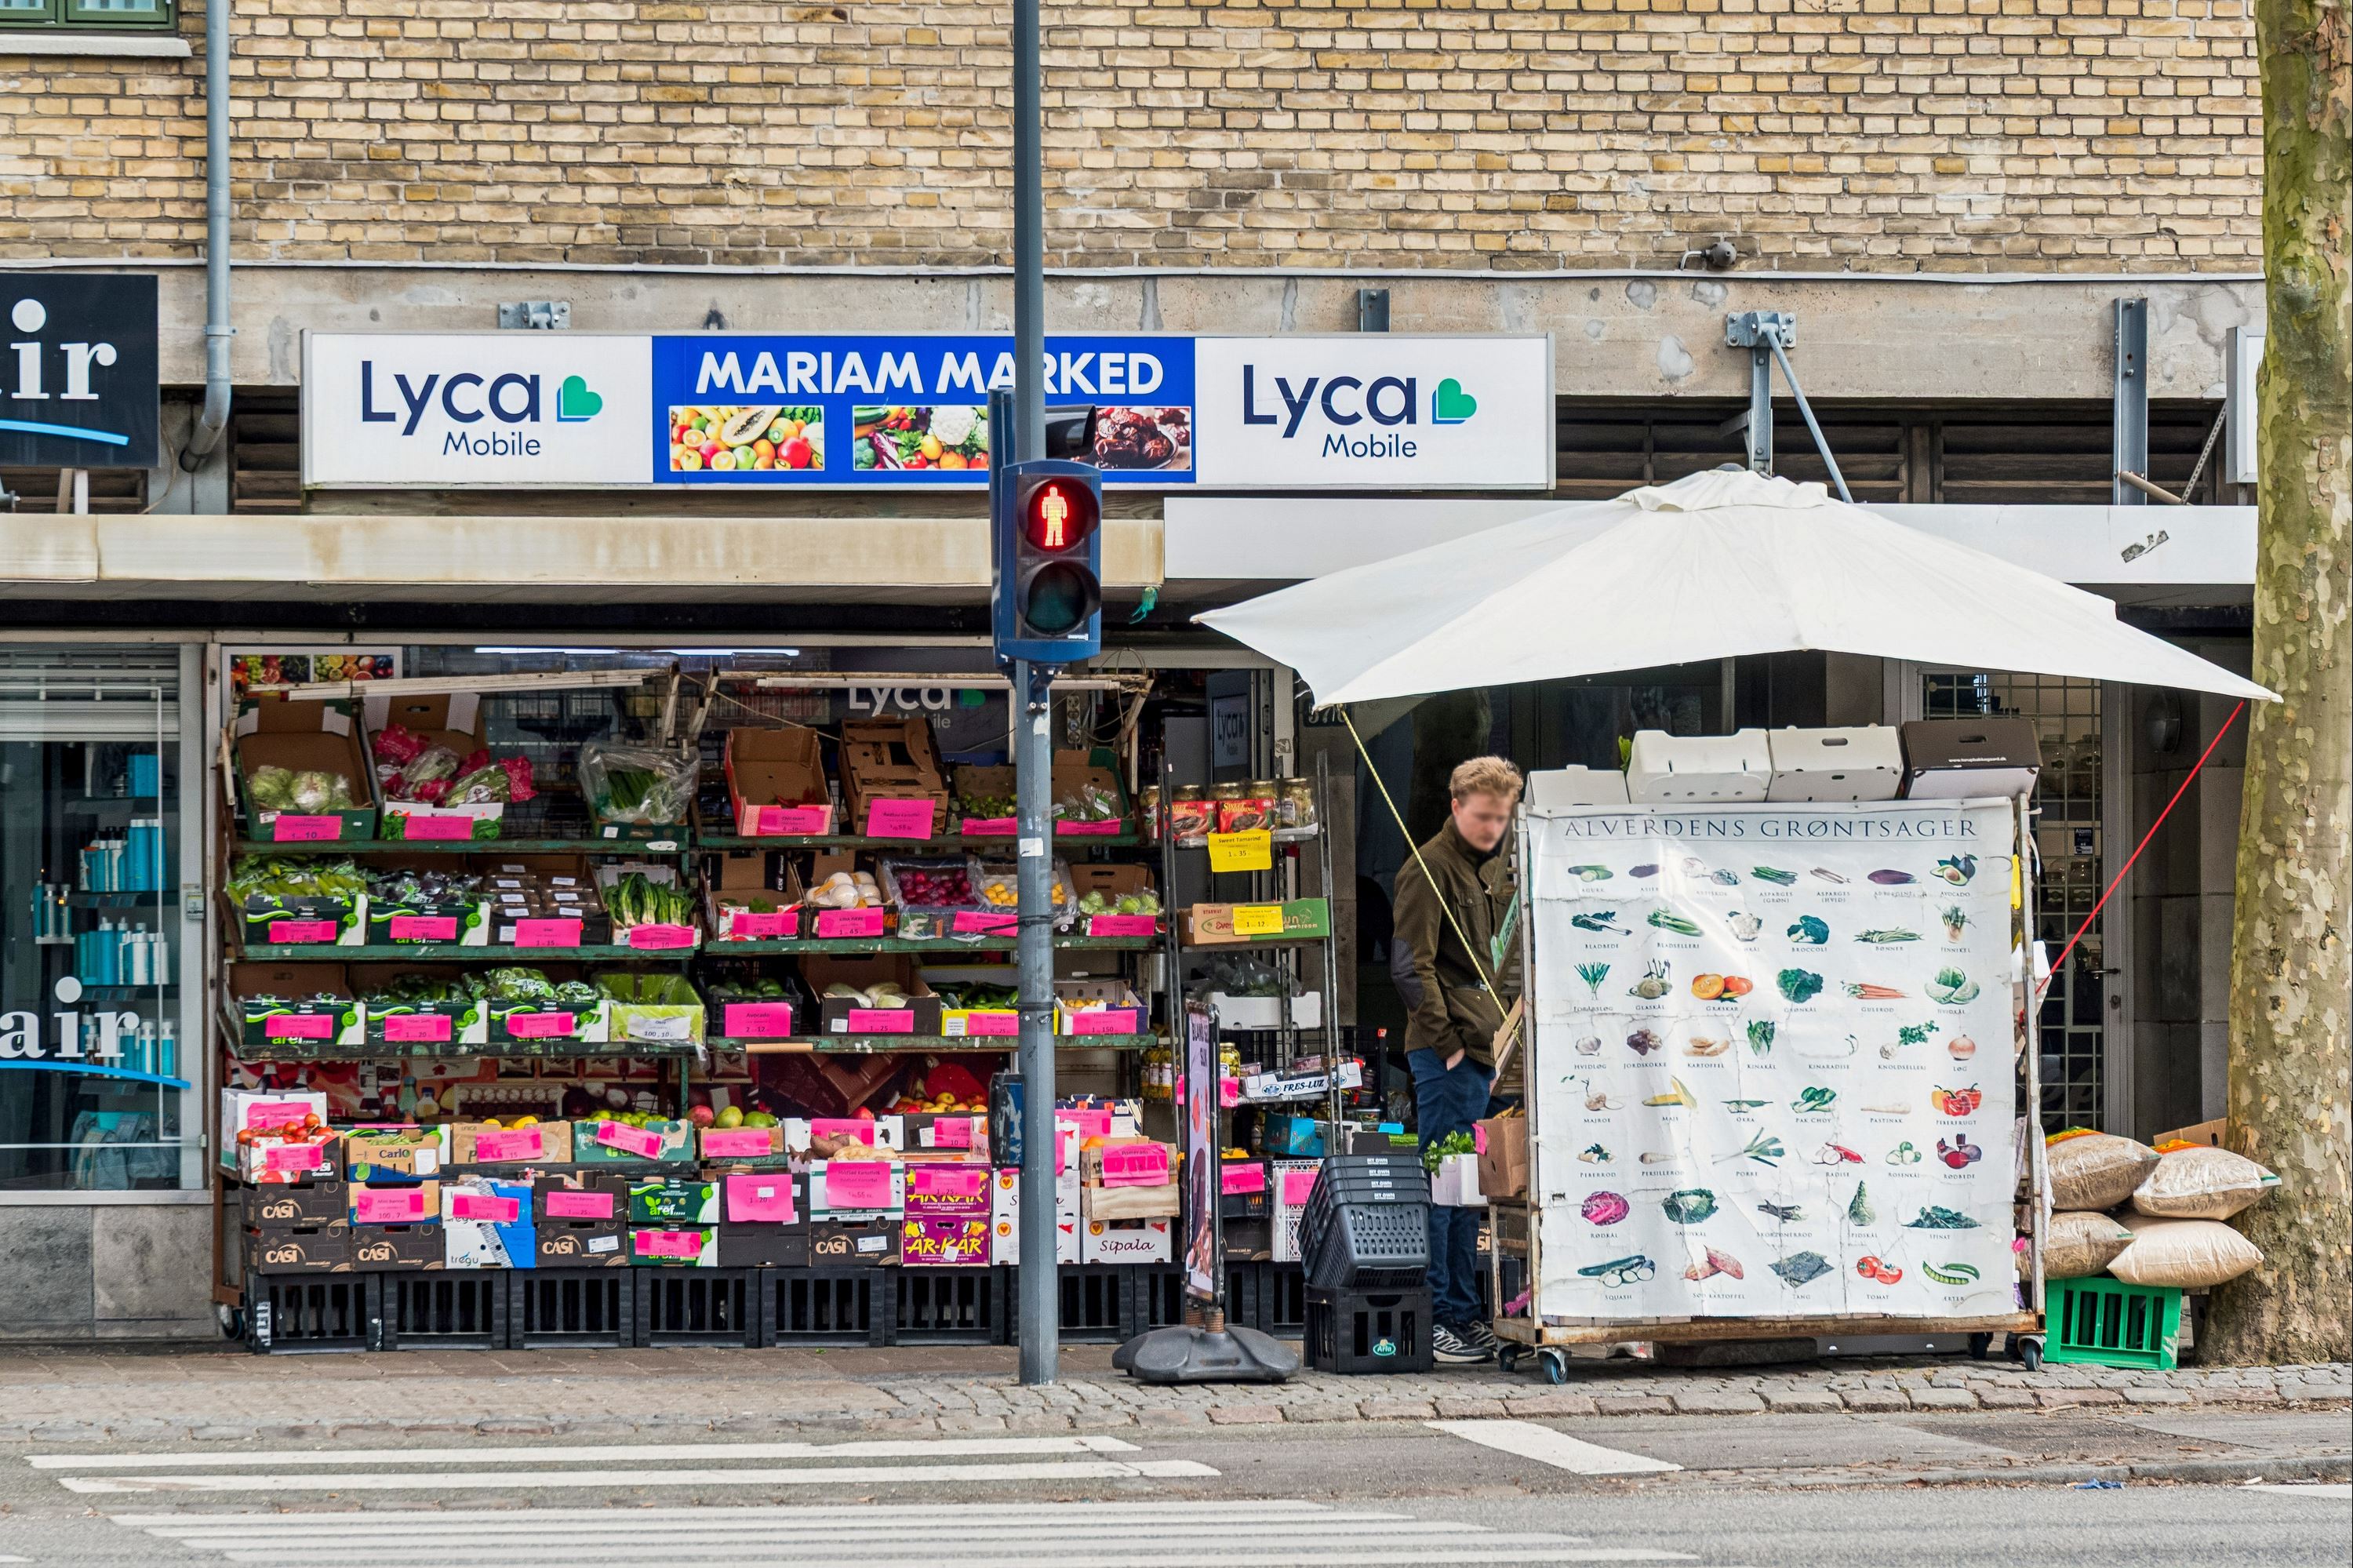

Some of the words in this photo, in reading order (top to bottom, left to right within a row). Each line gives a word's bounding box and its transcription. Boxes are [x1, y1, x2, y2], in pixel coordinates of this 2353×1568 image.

[696, 351, 923, 394] MARIAM
[362, 361, 540, 435] Lyca
[1244, 365, 1417, 438] Lyca
[442, 431, 541, 457] Mobile
[1322, 434, 1417, 458] Mobile
[849, 688, 951, 718] Lyca
[1223, 802, 1246, 811] SWEET
[1566, 819, 1744, 837] ALVERDENS
[1760, 820, 1977, 837] GRØNTSAGER
[0, 976, 140, 1059] air
[1283, 1079, 1324, 1092] FRES-LUZ
[380, 1149, 410, 1159] Carlo
[263, 1205, 293, 1218] CASI
[649, 1205, 677, 1217] aref
[358, 1247, 390, 1261] CASI
[541, 1242, 574, 1255] CASI
[816, 1241, 847, 1254] CASI
[265, 1250, 297, 1264] CASI
[451, 1251, 478, 1266] tregu
